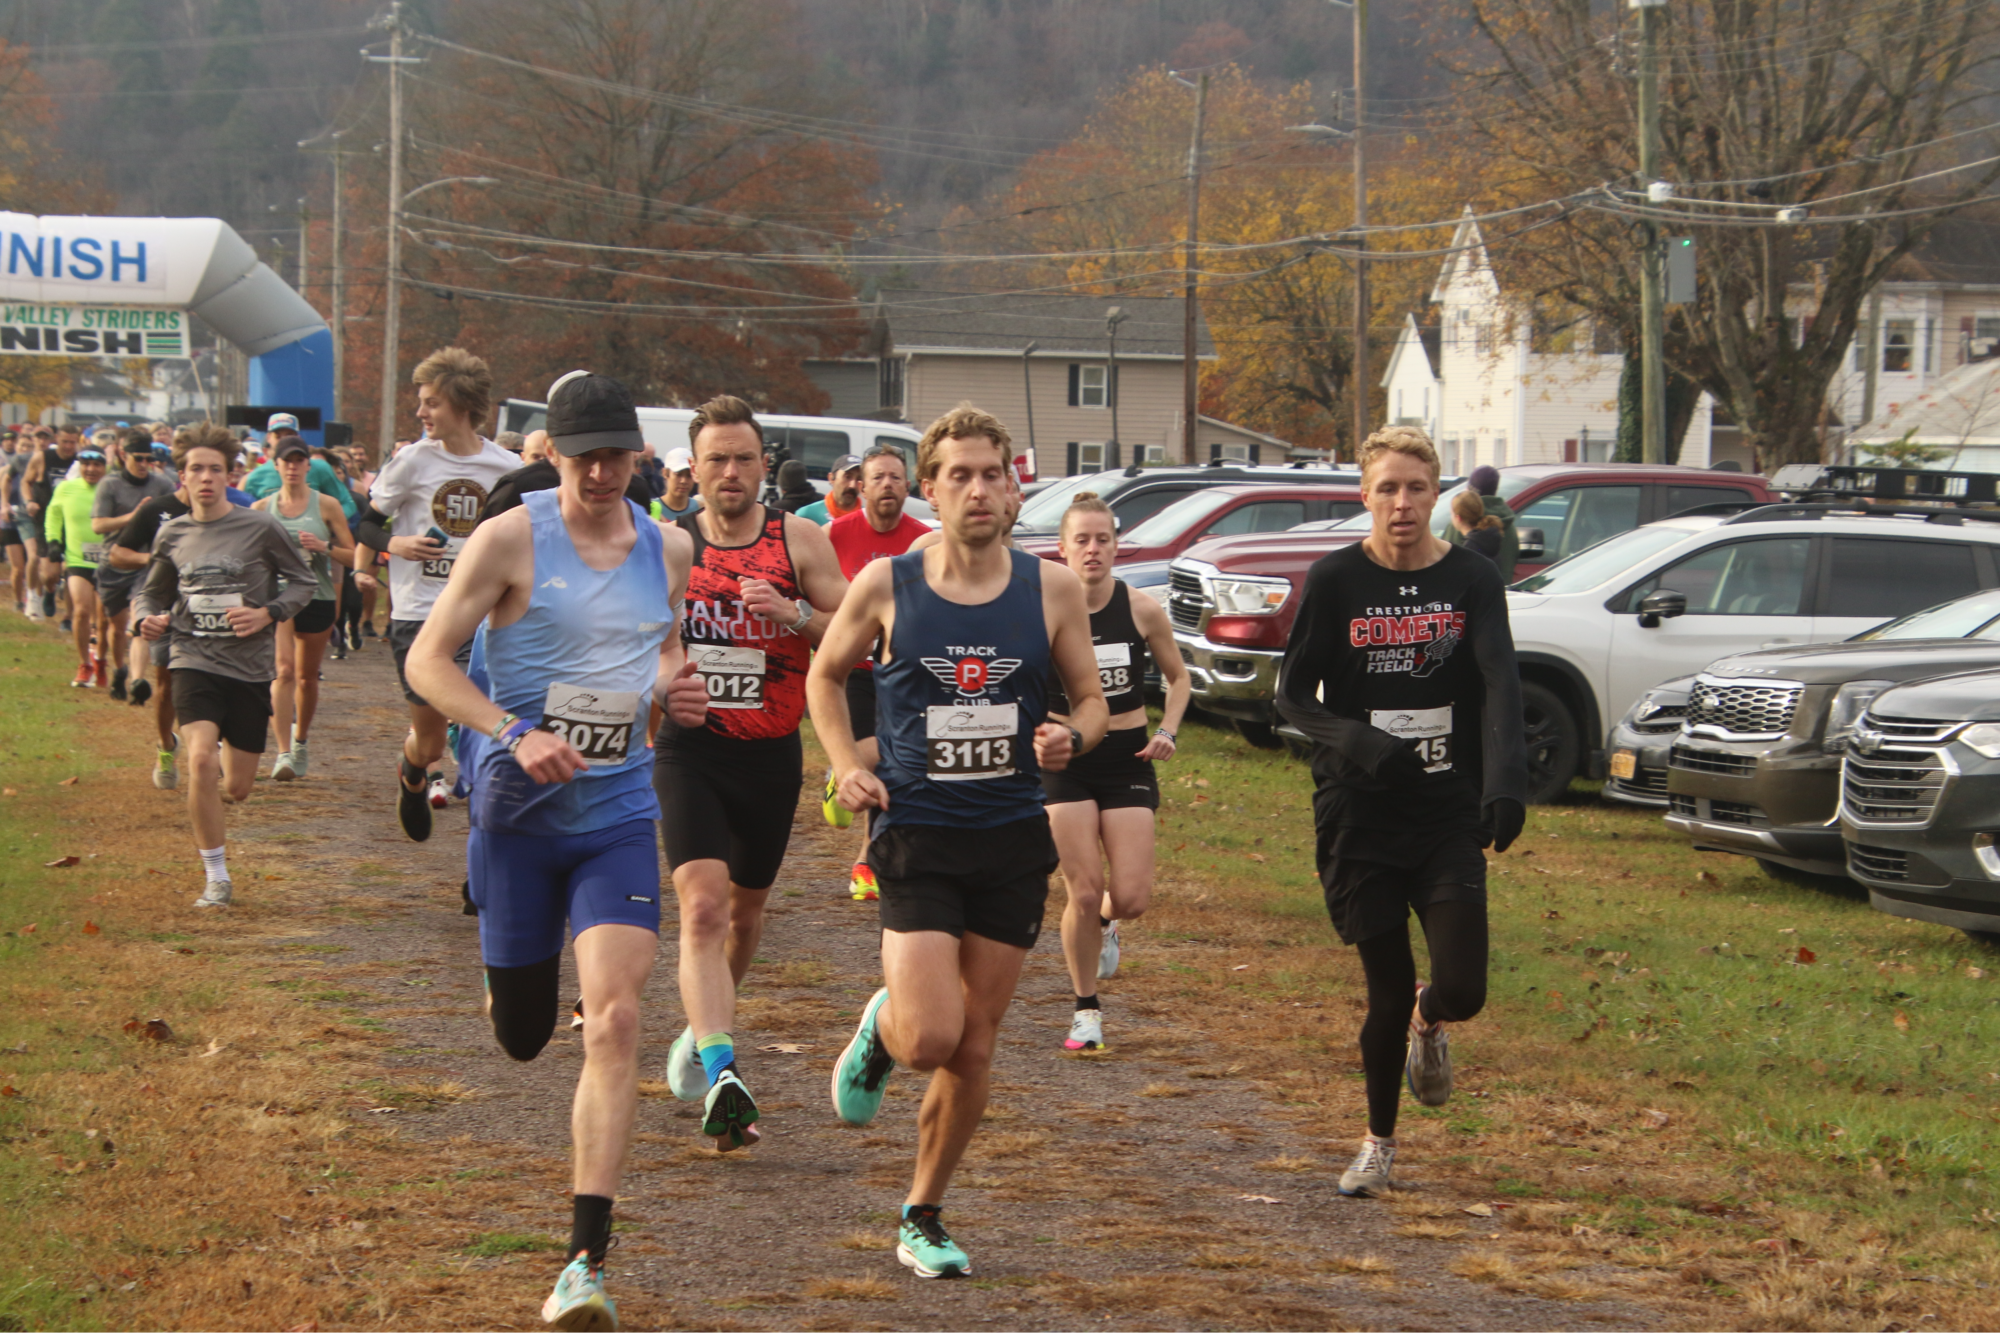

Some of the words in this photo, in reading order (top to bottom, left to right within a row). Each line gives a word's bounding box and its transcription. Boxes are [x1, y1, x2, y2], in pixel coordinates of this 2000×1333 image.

[0, 231, 146, 283] NISH
[4, 305, 73, 326] VALLEY
[82, 308, 181, 330] STRIDERS
[446, 494, 478, 520] 50
[425, 560, 451, 575] 30
[1366, 603, 1453, 616] CRESTWOOD
[1350, 611, 1466, 648] COMETS
[945, 646, 997, 656] TRACK
[1366, 648, 1416, 661] TRACK
[702, 659, 727, 667] Scranton
[1366, 659, 1414, 673] FIELD
[1099, 668, 1129, 688] 38
[567, 704, 599, 716] Scranton
[600, 709, 627, 719] Running
[947, 724, 978, 732] Scranton
[979, 723, 1006, 732] Running
[1418, 724, 1442, 732] Running
[548, 719, 628, 753] 3074
[934, 739, 1011, 768] 3113
[1414, 737, 1447, 763] 15
